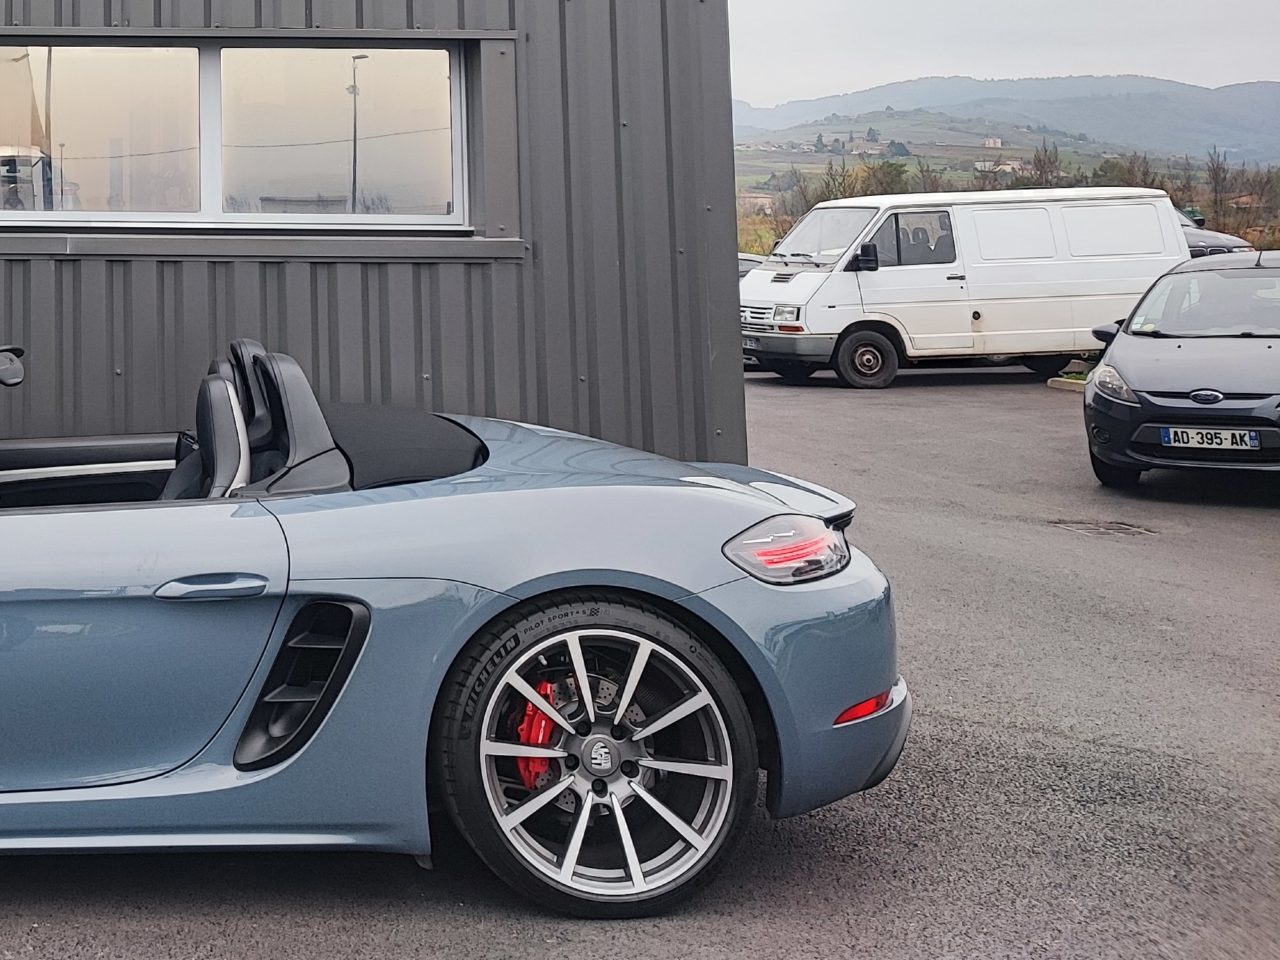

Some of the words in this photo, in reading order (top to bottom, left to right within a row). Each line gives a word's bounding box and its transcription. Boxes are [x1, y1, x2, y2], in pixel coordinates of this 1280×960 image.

[1173, 430, 1248, 447] AD-395-AK
[465, 637, 516, 716] MICHELIN
[523, 619, 544, 634] PILOT
[547, 611, 574, 623] SPORT
